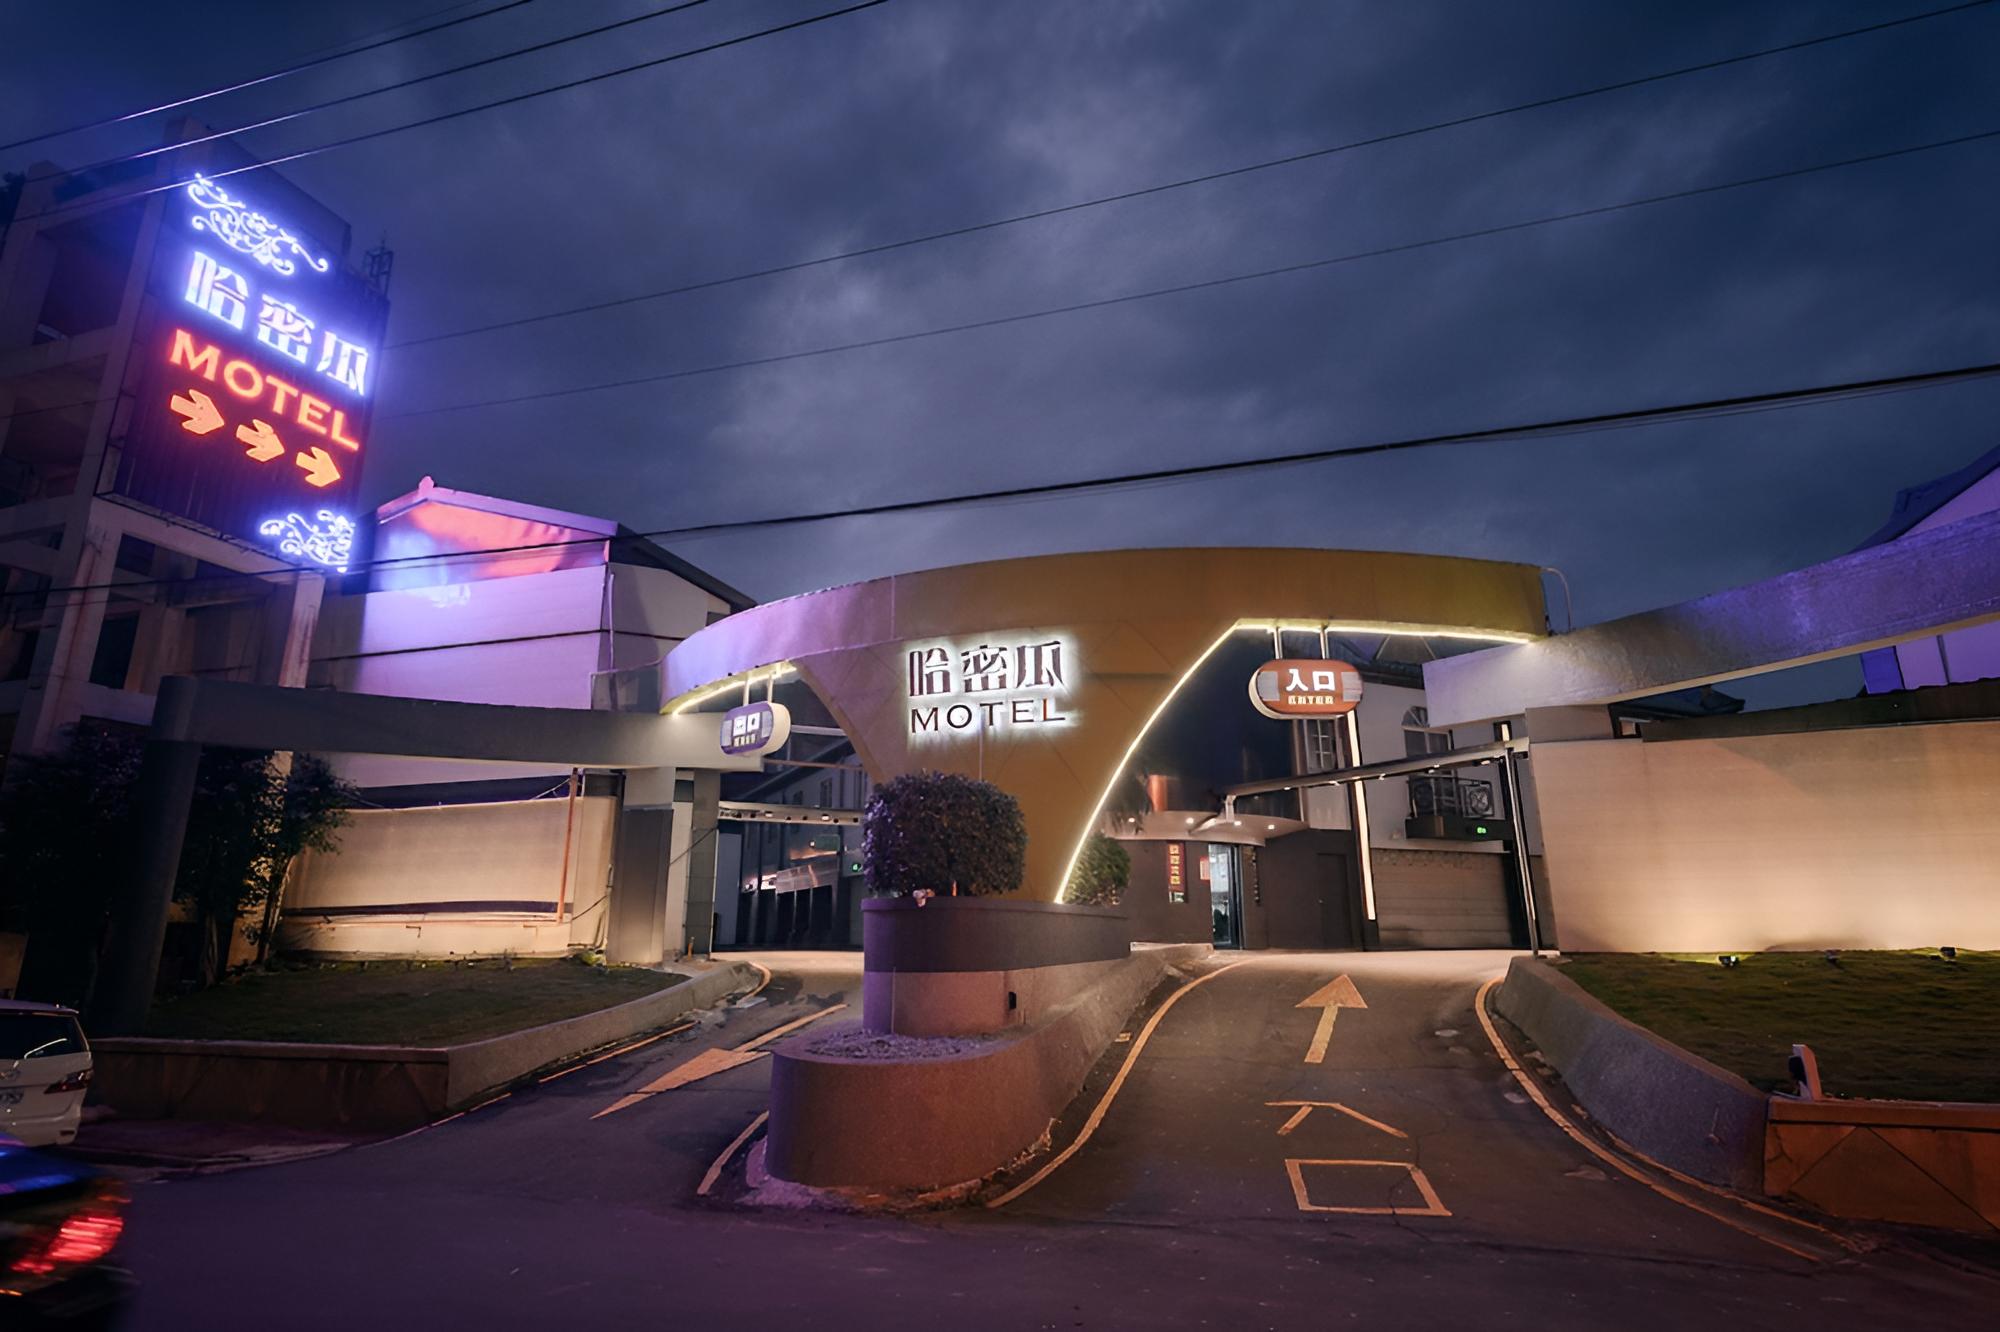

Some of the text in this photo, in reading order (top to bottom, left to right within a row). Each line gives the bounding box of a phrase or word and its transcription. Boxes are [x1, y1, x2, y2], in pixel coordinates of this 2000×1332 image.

[185, 251, 369, 395] 哈密瓜
[170, 328, 359, 451] MOTEL
[908, 640, 1066, 697] 哈密瓜
[1285, 668, 1336, 692] 入口
[911, 698, 1066, 734] MOTEL
